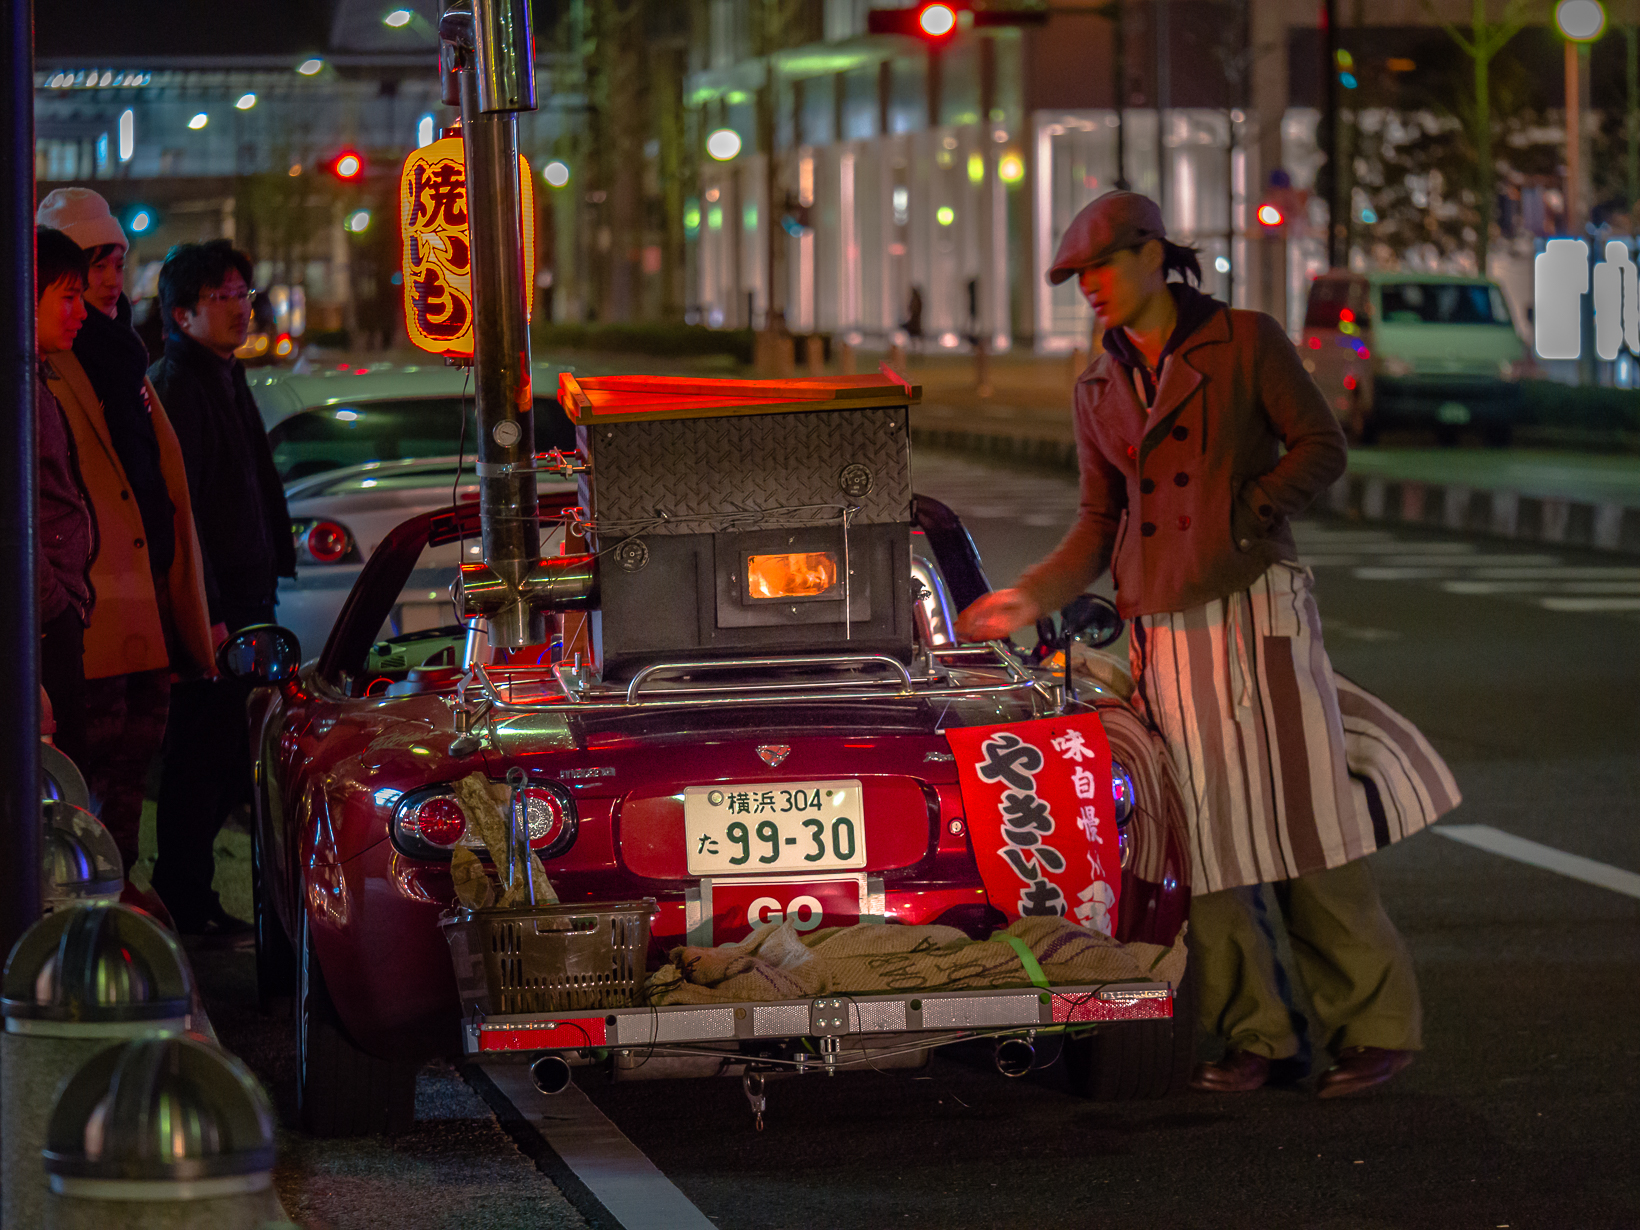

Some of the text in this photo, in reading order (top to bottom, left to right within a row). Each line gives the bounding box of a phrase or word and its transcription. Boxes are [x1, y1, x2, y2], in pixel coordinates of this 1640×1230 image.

[407, 160, 472, 340] 焼いも
[1051, 729, 1104, 845] 味自慢
[697, 817, 856, 866] た 99-30
[747, 895, 823, 932] GO
